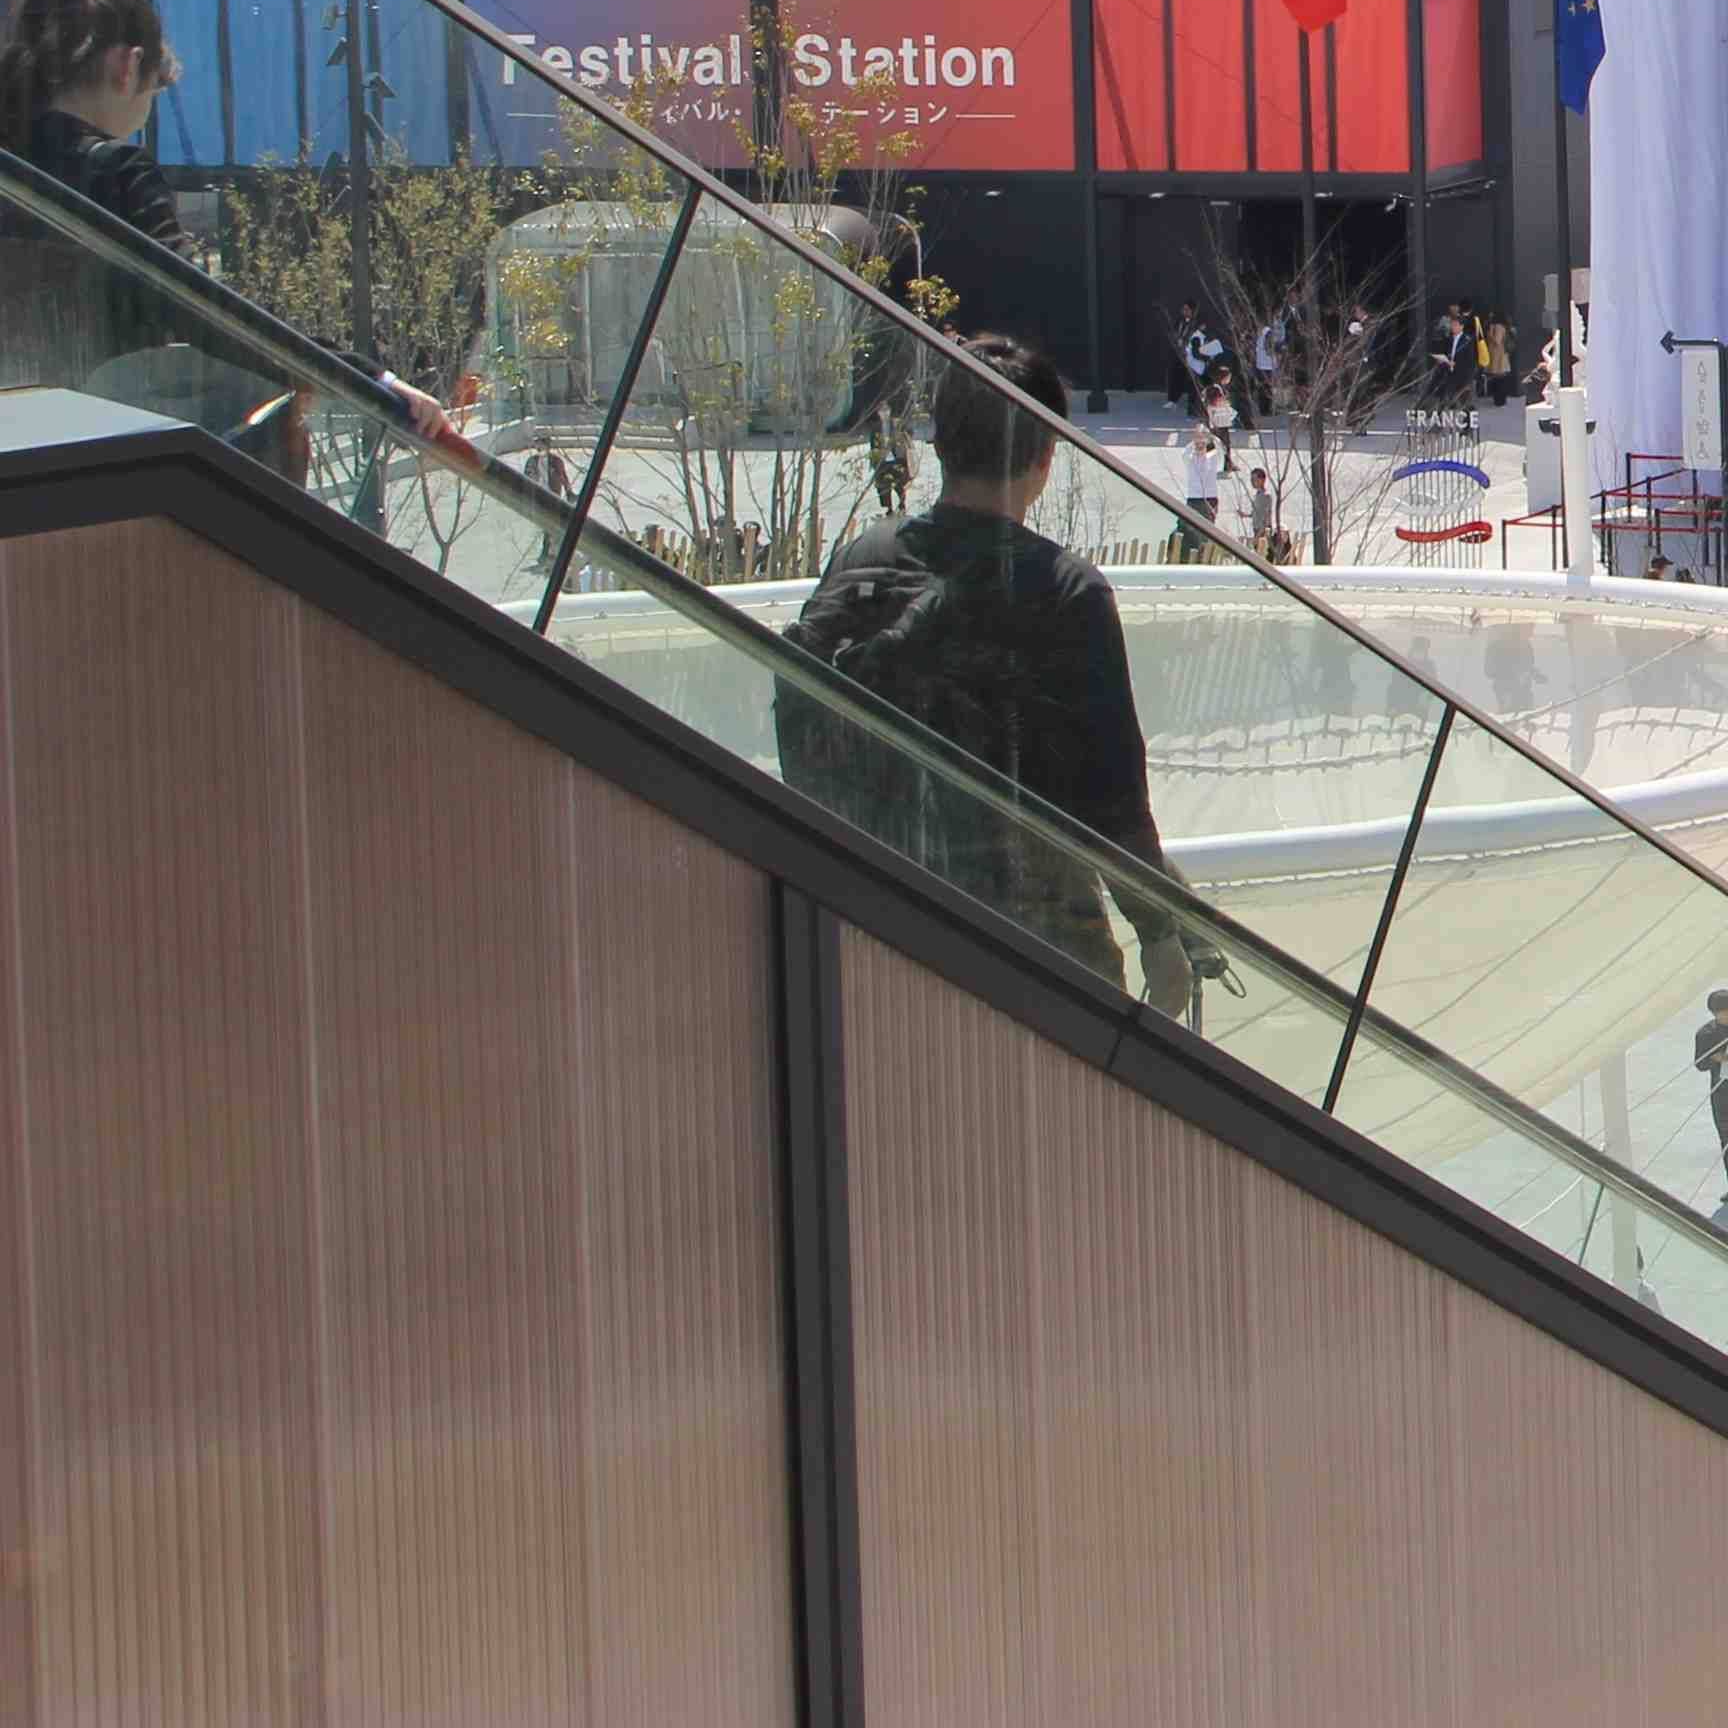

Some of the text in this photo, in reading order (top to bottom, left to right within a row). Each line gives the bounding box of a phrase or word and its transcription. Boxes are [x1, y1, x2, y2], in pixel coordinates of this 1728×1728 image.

[503, 33, 1016, 87] Festival Station
[1406, 409, 1480, 429] FRANCE
